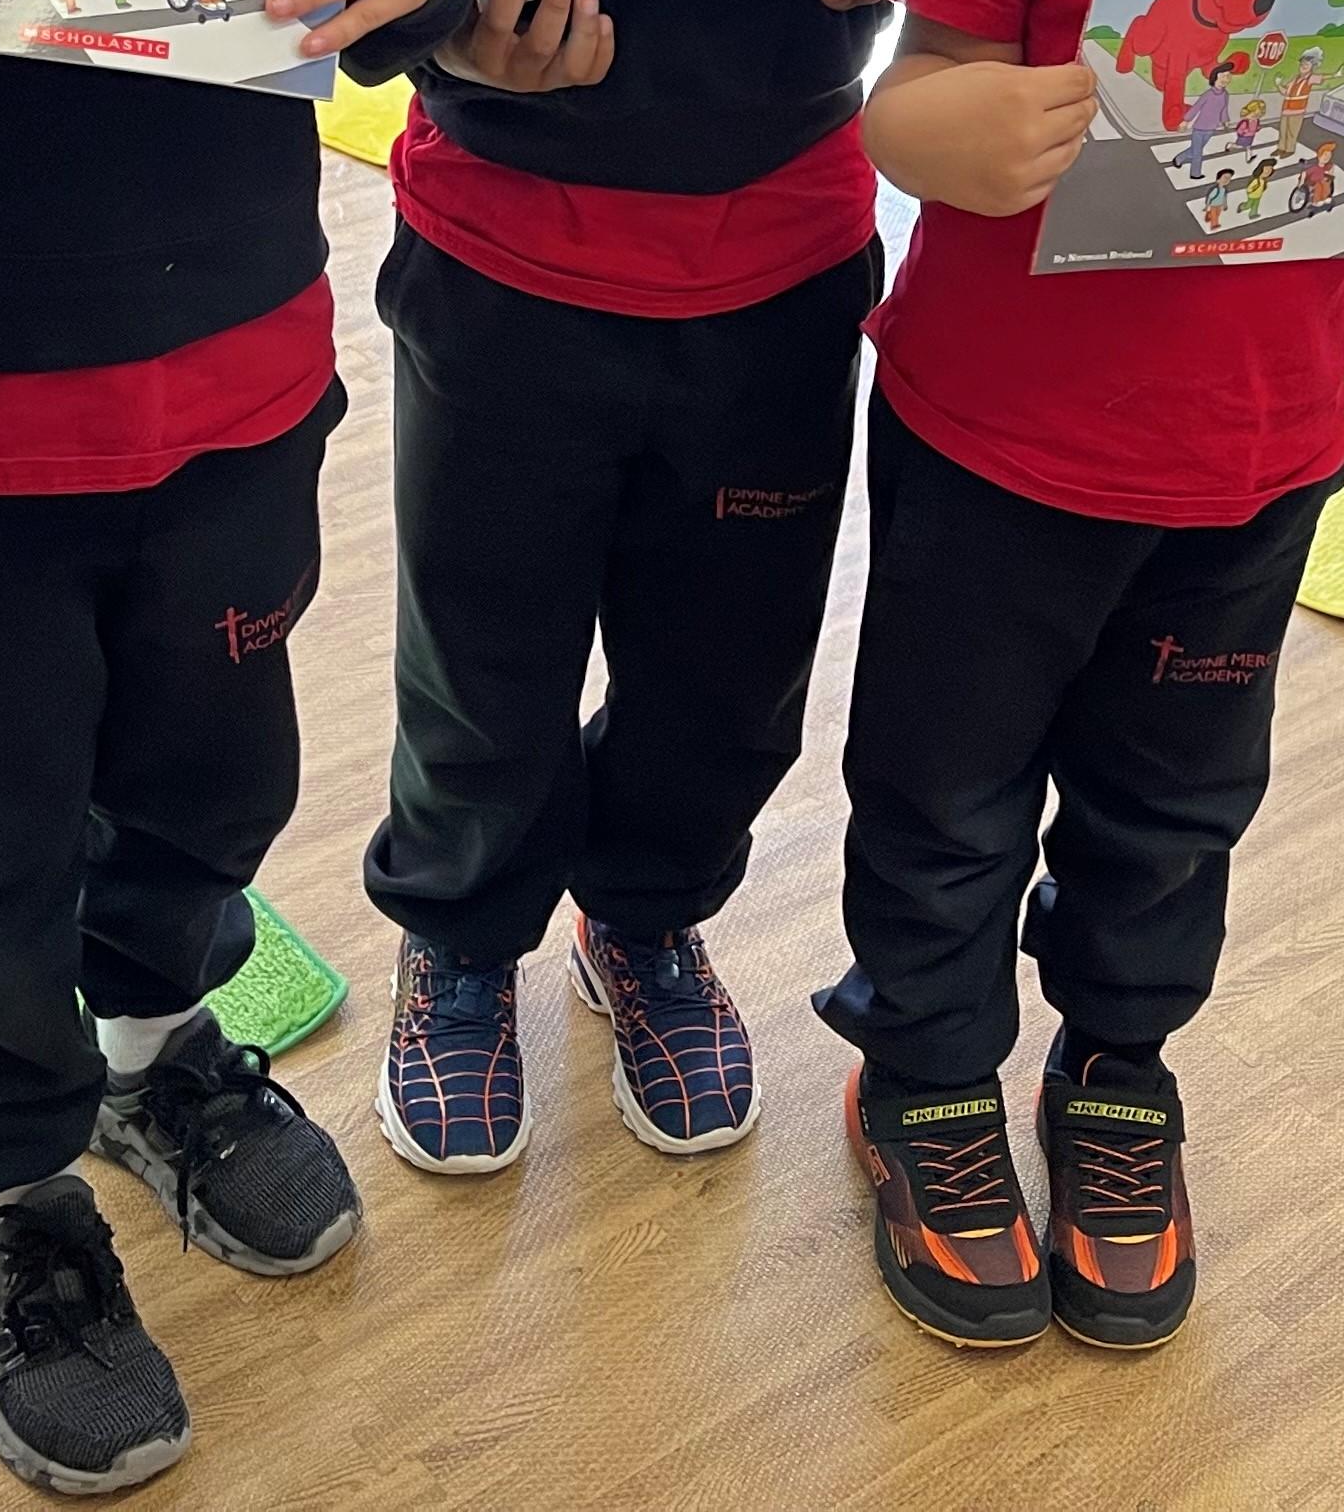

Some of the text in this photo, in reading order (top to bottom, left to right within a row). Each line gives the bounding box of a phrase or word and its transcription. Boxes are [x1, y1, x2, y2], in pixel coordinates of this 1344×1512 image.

[40, 29, 167, 55] SCHOLASTIC
[1259, 40, 1284, 60] STOP
[1186, 238, 1283, 255] SCHOLASTIC
[728, 489, 784, 503] DIVINE
[1172, 654, 1227, 668] DIVINE
[1168, 670, 1253, 684] ACADEMY
[903, 1099, 998, 1125] SKECHERS
[1067, 1101, 1166, 1125] SKECHERS
